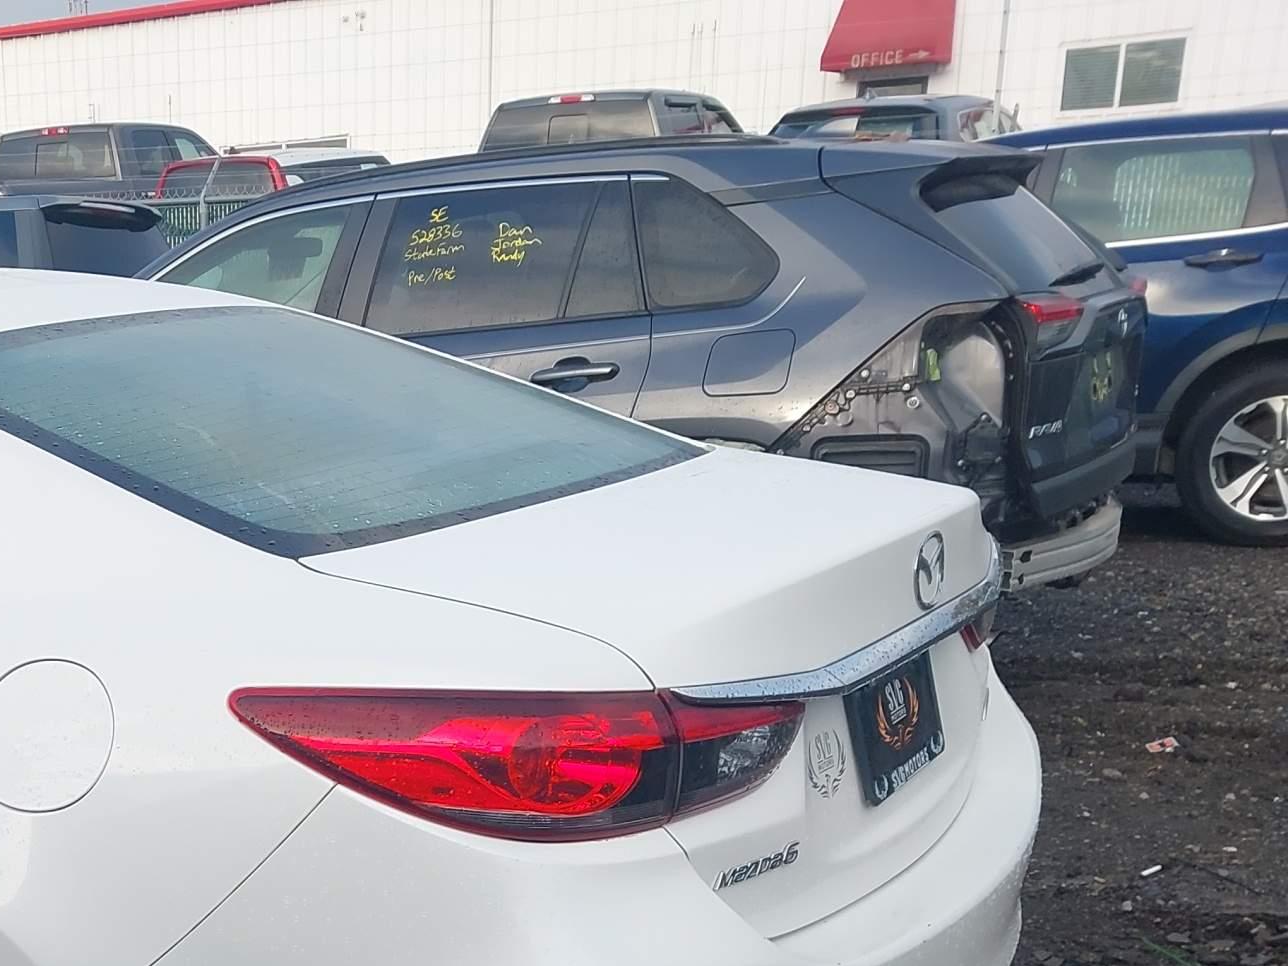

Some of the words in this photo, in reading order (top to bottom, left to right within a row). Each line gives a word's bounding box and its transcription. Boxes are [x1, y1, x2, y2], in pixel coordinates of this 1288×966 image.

[851, 48, 904, 69] OFFICE
[429, 205, 449, 223] SE
[409, 223, 463, 246] 528336
[499, 222, 533, 237] Dan
